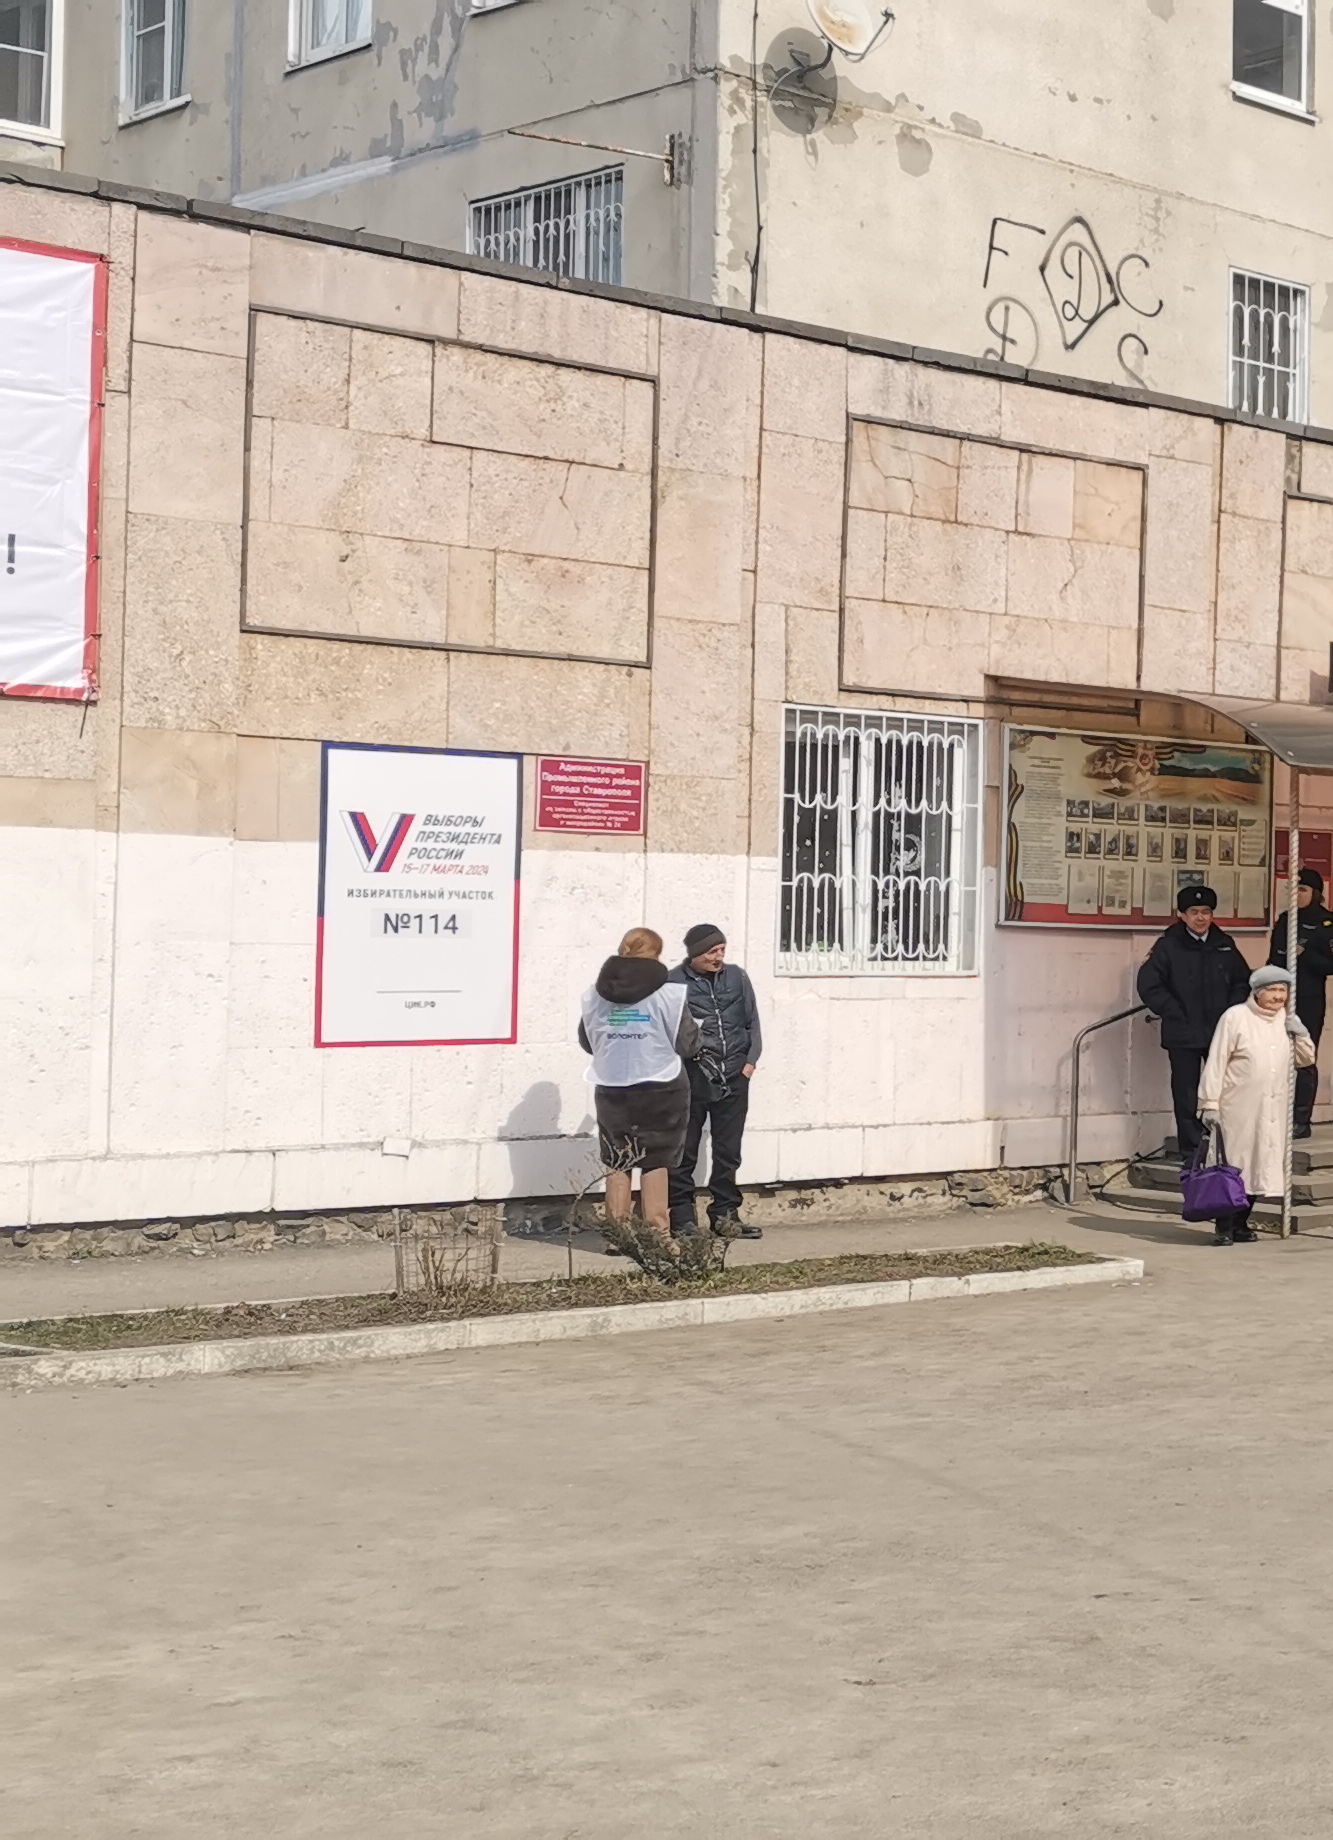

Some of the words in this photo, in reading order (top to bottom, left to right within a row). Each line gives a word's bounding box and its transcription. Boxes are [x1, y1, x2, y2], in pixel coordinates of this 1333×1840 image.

[422, 814, 485, 828] ВЫБОРЫ
[414, 831, 503, 846] ПРЕЗИДЕНТА
[406, 847, 466, 861] РОССИИ
[430, 863, 464, 875] МАРТА
[464, 865, 490, 876] 2024
[347, 888, 445, 900] ИЗБИРАТЕЛЬНЫЙ
[447, 889, 495, 901] УЧАСТОК
[383, 912, 459, 935] №114
